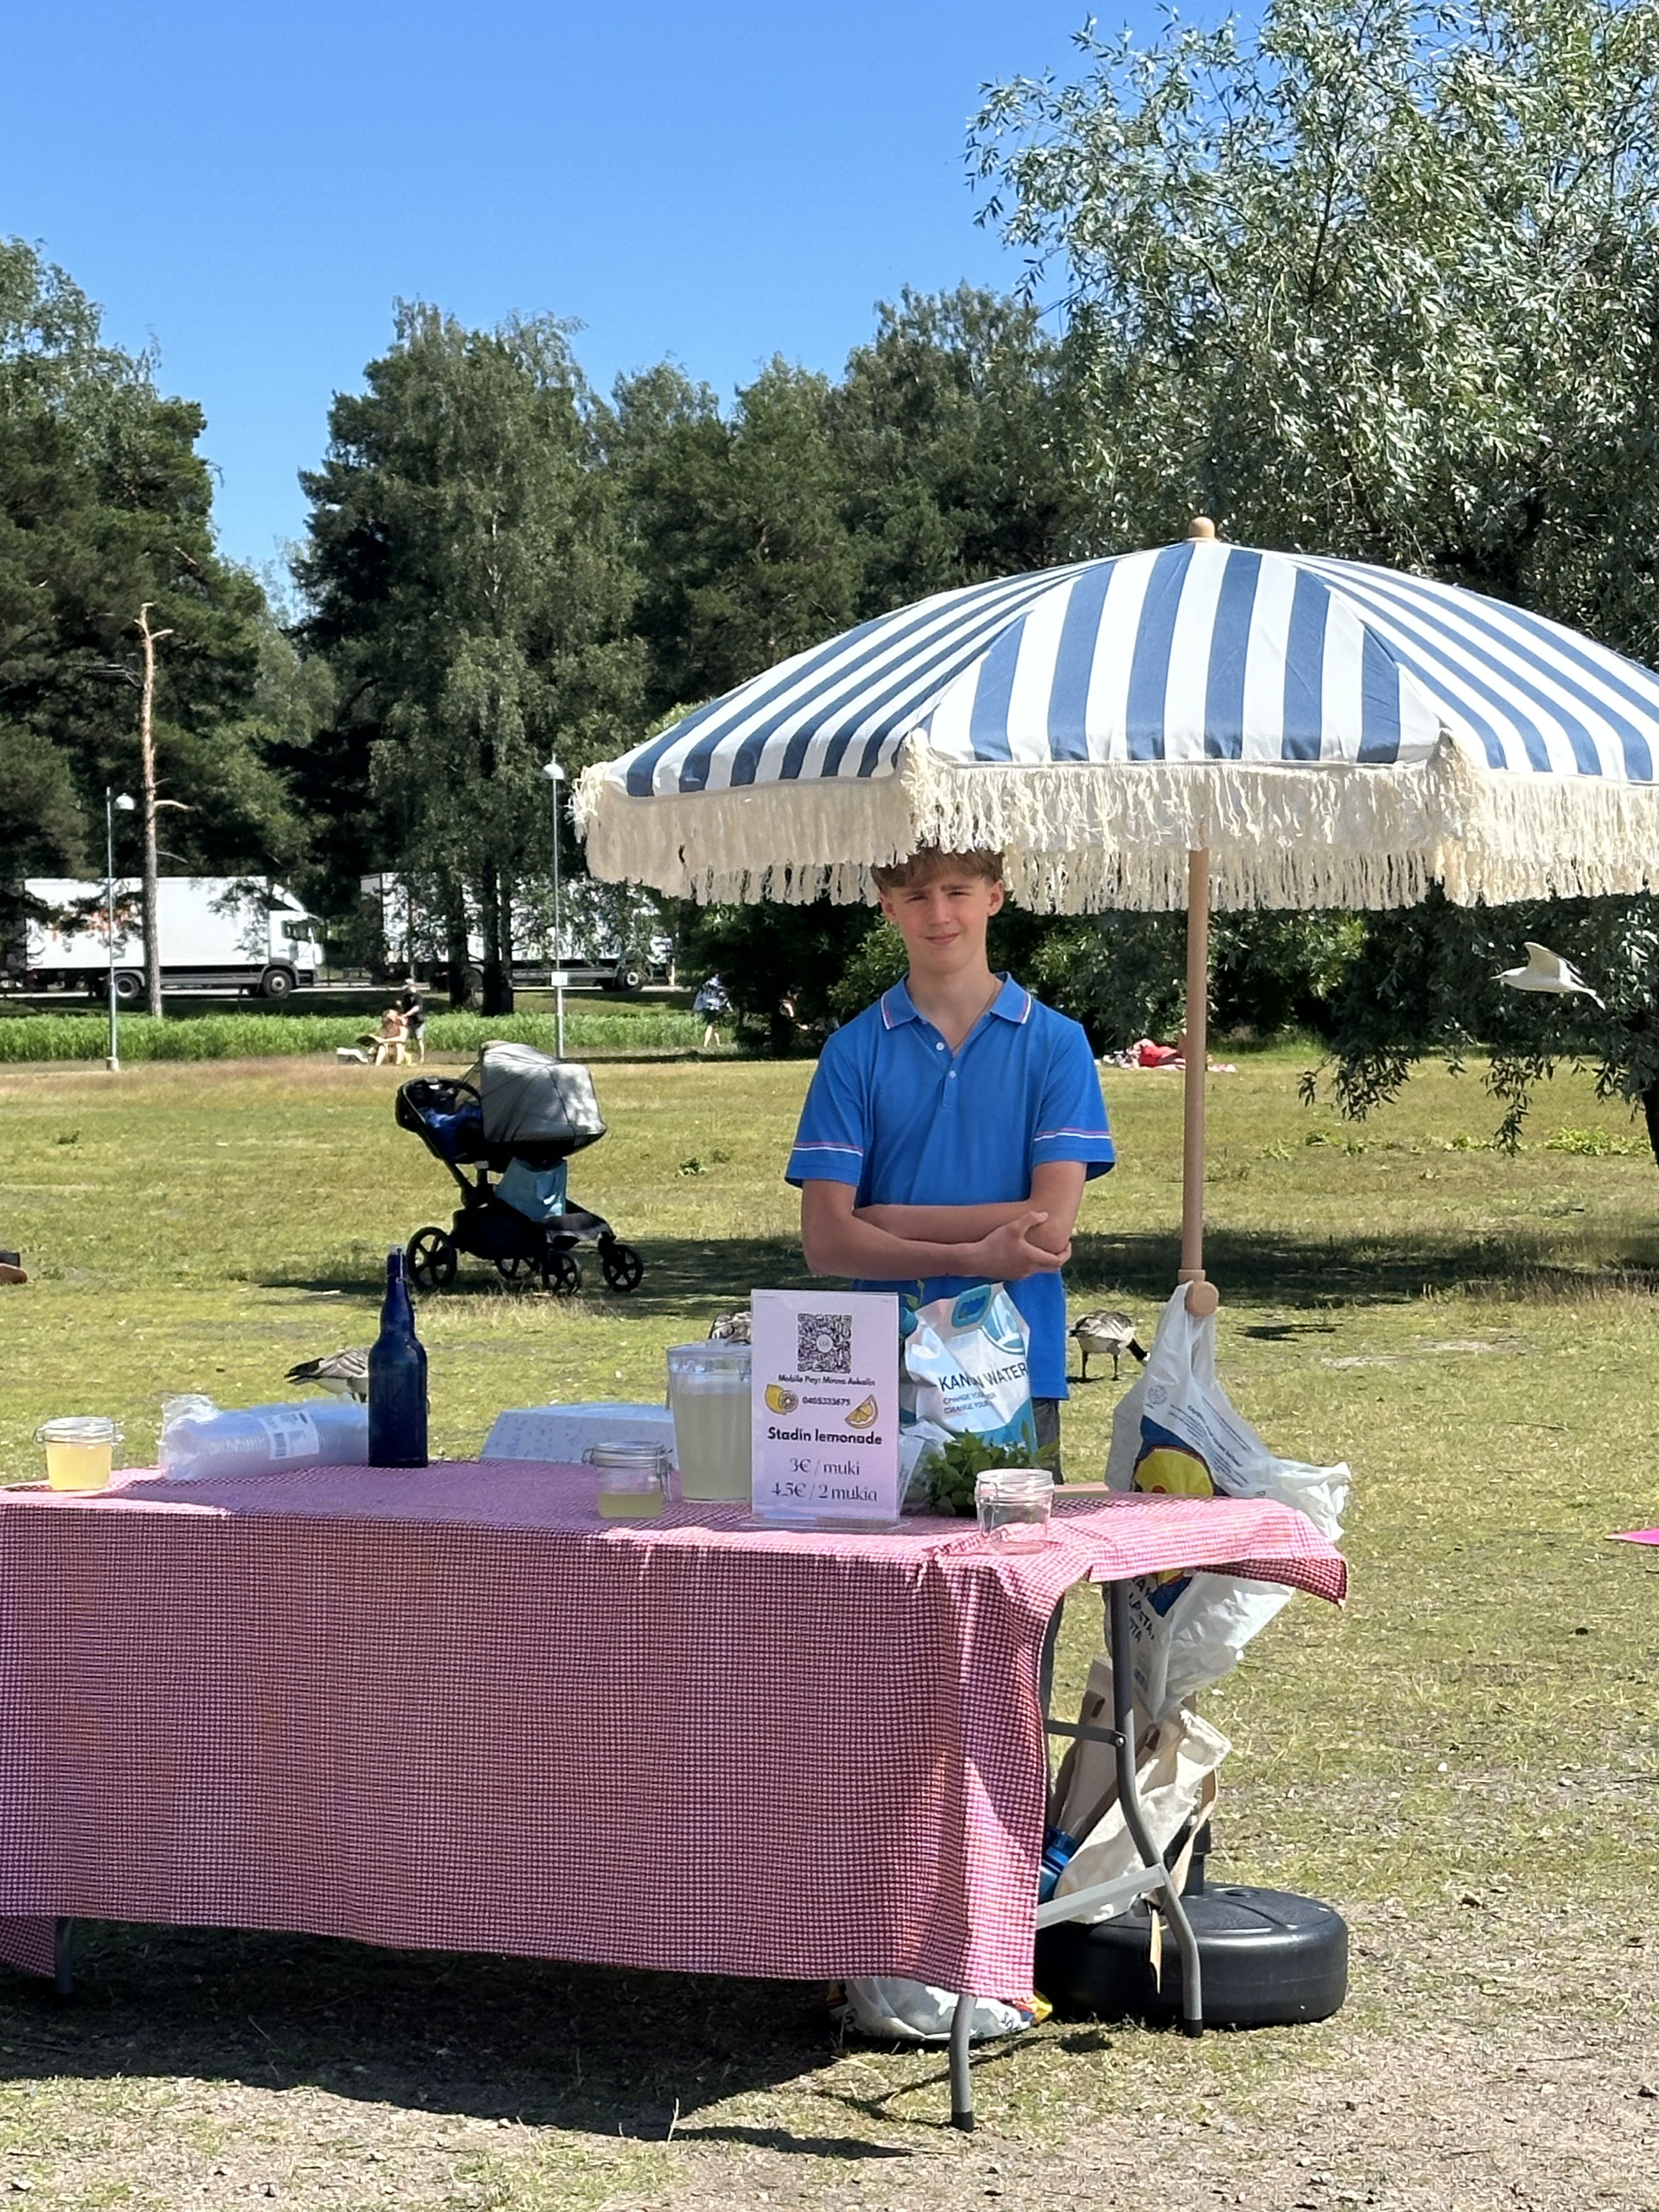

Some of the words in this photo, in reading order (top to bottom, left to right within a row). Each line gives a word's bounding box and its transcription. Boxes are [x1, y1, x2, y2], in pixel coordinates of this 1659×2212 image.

[778, 1374, 803, 1383] Mobile
[984, 1362, 1028, 1386] WATER
[767, 1426, 811, 1442] Stadin
[815, 1428, 882, 1445] lemonade
[789, 1457, 811, 1473] 3€
[814, 1459, 821, 1475] /
[823, 1460, 860, 1476] muki
[809, 1483, 815, 1501] /
[818, 1483, 828, 1498] 2
[831, 1485, 877, 1502] mukia
